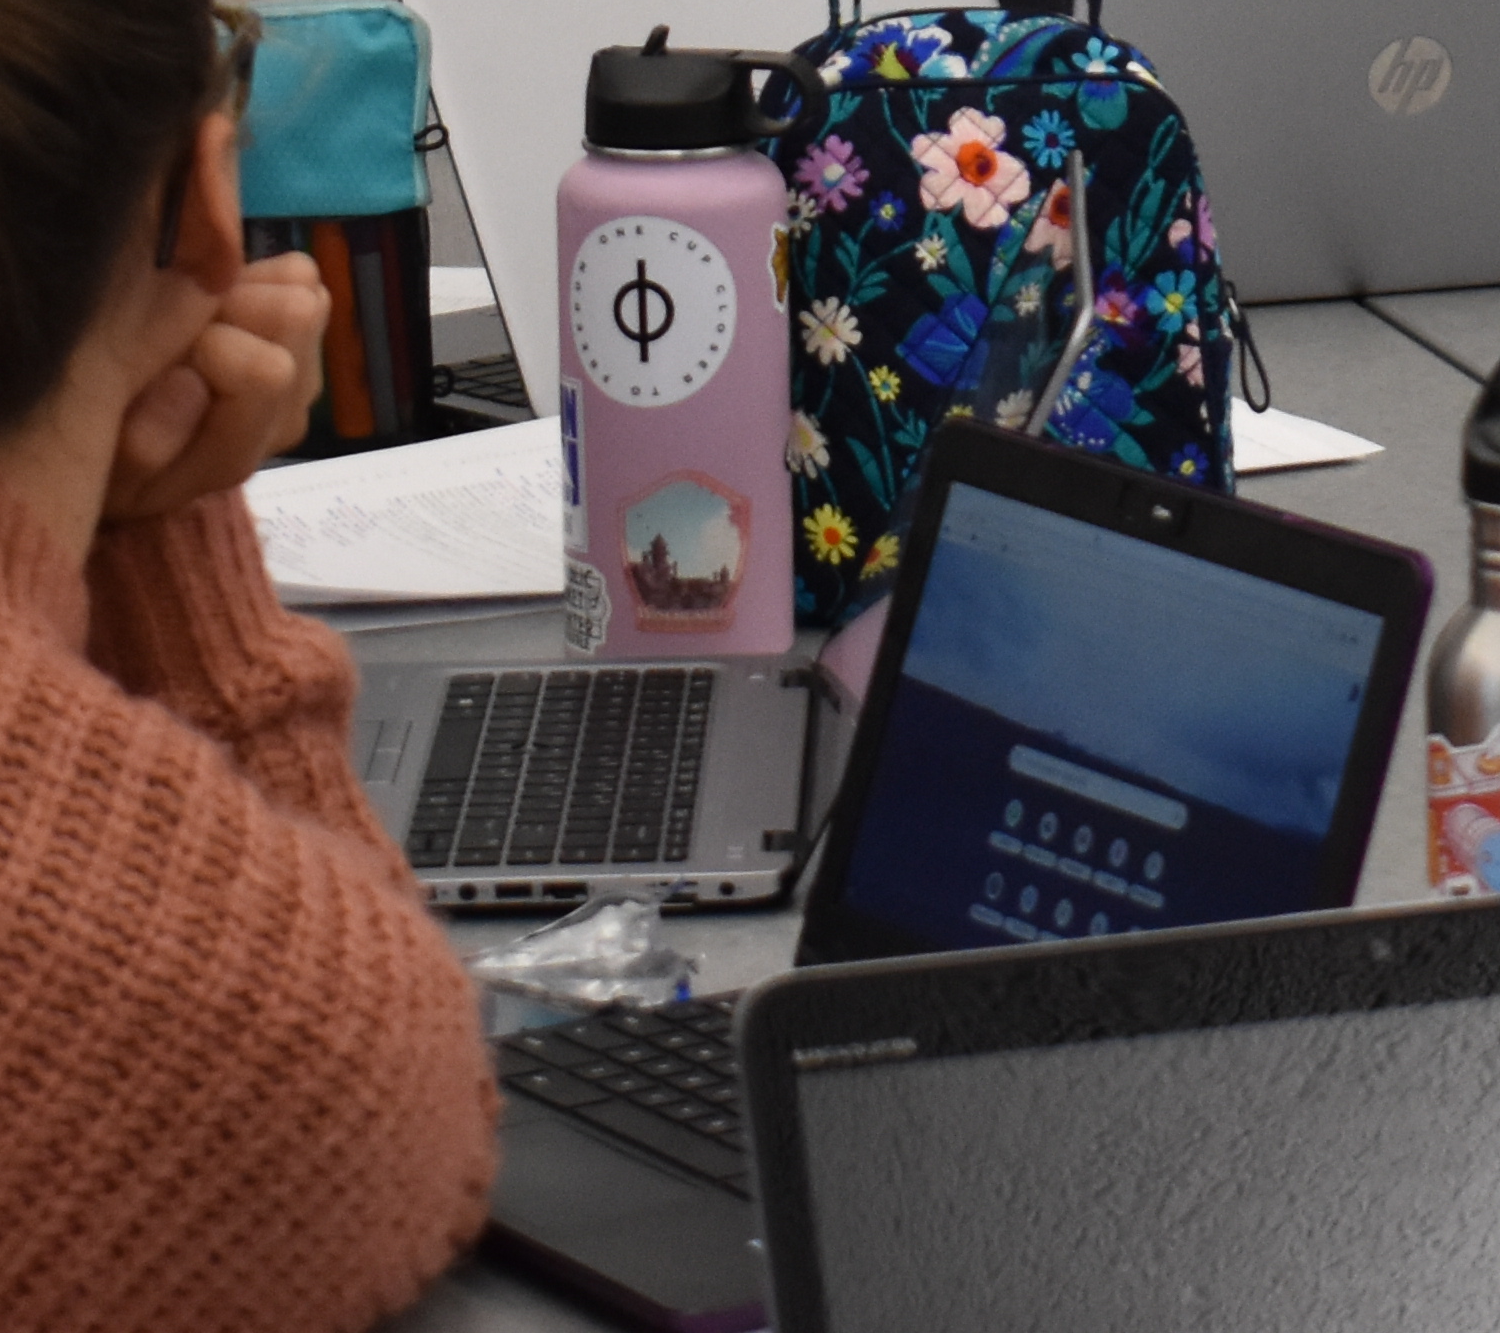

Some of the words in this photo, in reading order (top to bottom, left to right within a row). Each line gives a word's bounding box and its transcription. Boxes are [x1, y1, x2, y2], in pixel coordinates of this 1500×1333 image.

[1368, 35, 1452, 117] hp
[599, 224, 645, 245] ONE
[668, 230, 712, 264] CUP
[683, 284, 728, 384] CLOSER
[630, 385, 661, 397] TO
